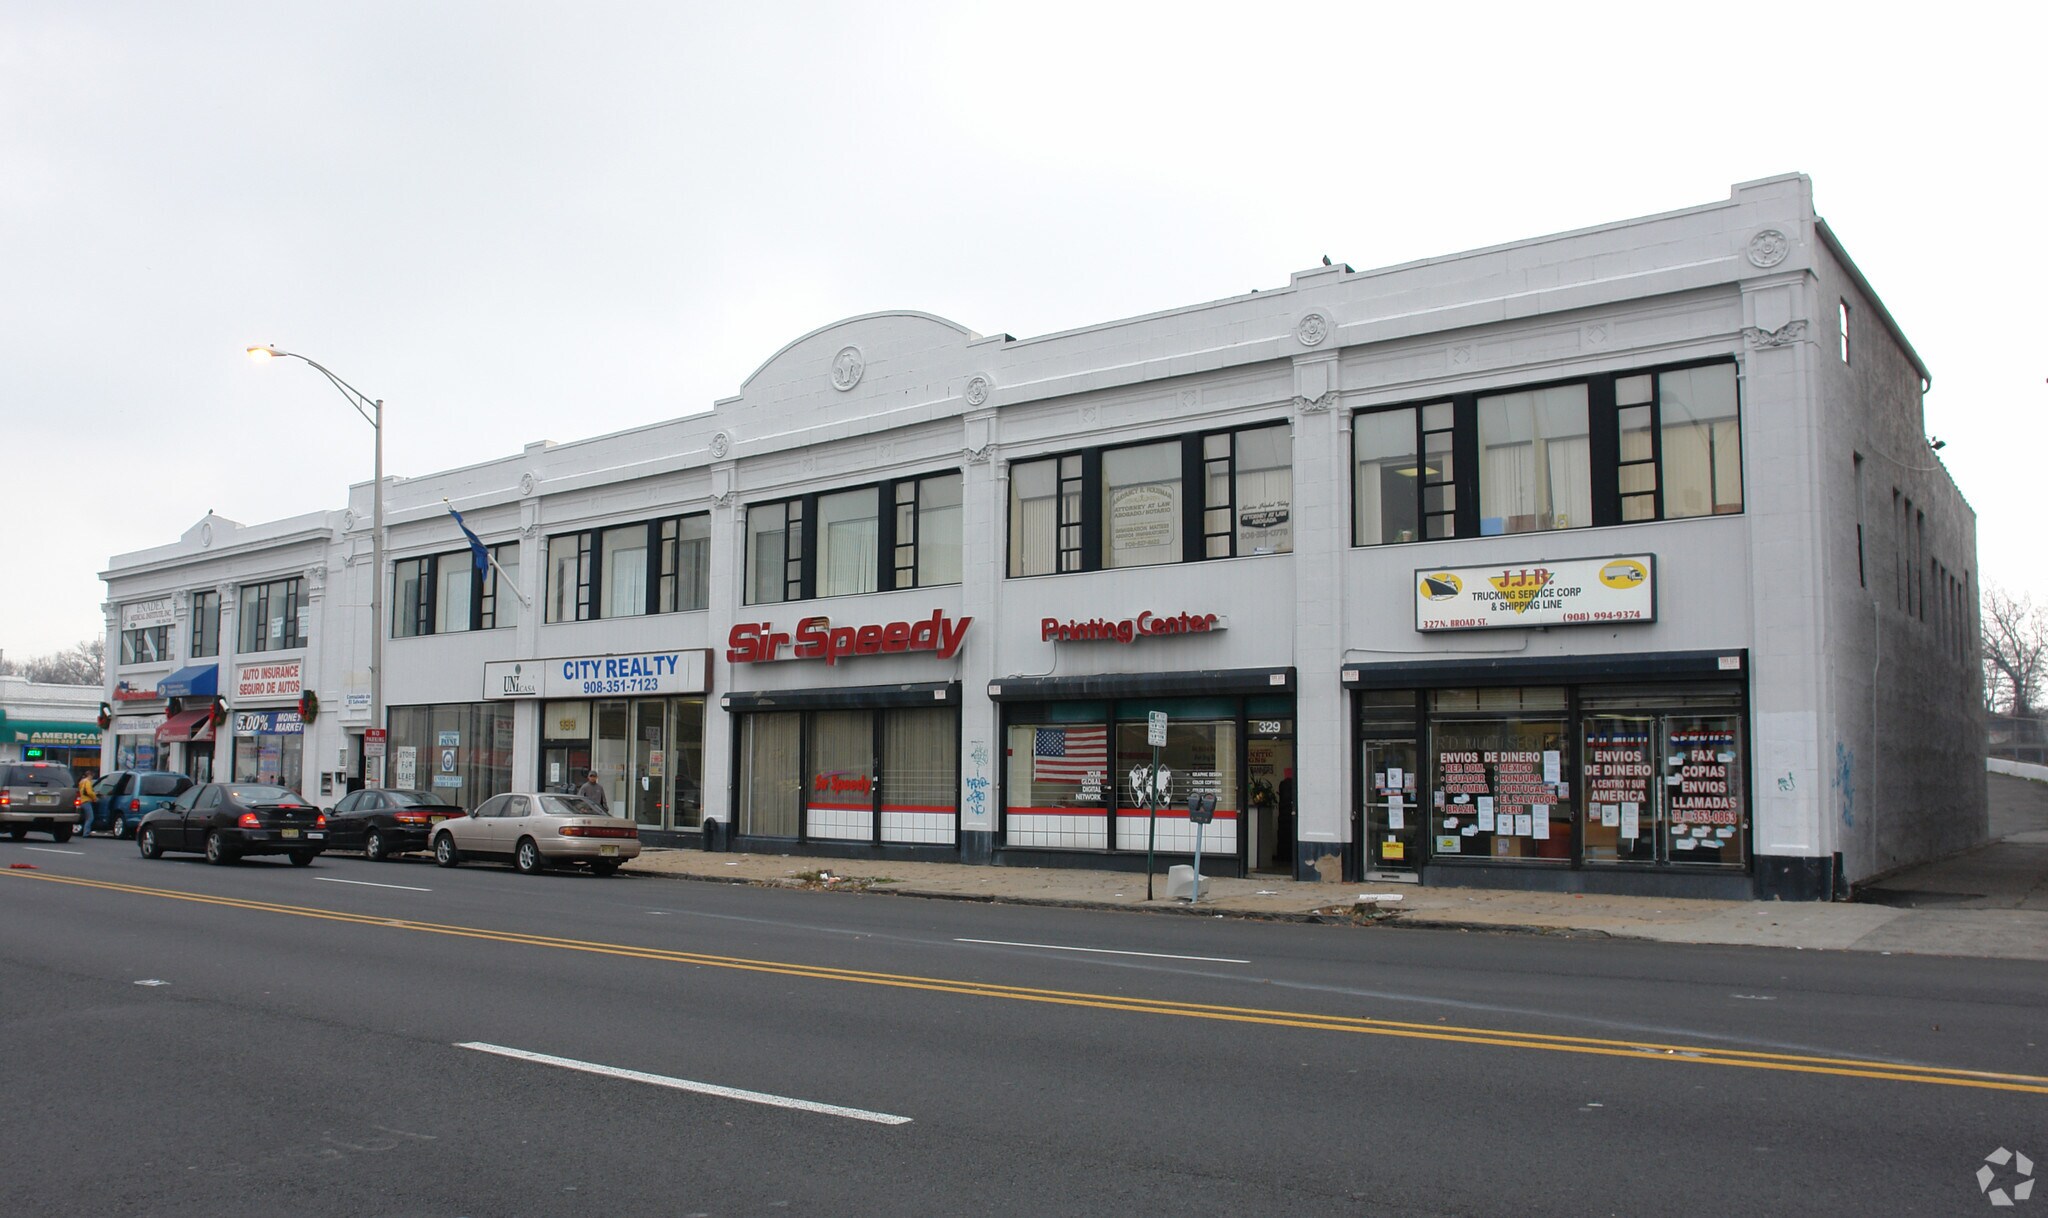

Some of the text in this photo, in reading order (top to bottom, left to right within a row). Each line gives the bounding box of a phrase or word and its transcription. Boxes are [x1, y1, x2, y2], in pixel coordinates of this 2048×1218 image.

[1472, 587, 1581, 601] TRUCKING SERVICE CORP
[1491, 600, 1562, 612] & SHIPPING LINE
[1563, 610, 1641, 623] (908) 994-9374
[1041, 610, 1218, 643] Printing Center
[1451, 619, 1475, 629] BROAD
[1477, 618, 1488, 627] ST.
[726, 608, 974, 667] Sir Speedy
[242, 665, 299, 681] AUTO INSURANCE
[563, 655, 679, 680] CITY REALTY
[239, 680, 300, 695] SEGURO DE AUTOS
[583, 678, 659, 694] 908-351-7123
[236, 714, 269, 731] 5.00%
[274, 722, 304, 732] MARKET
[1259, 721, 1280, 733] 329
[1670, 730, 1735, 746] SERVICE
[1440, 752, 1540, 763] ENVIOS DE DINERO
[1595, 751, 1641, 762] ENVIOS
[1692, 750, 1714, 762] FAX
[1446, 764, 1486, 773] REP. DOM.
[1500, 763, 1533, 773] MEXICO
[1585, 765, 1651, 776] DE DINERO
[1682, 766, 1725, 777] COPIAS
[1446, 774, 1486, 783] ECUADOR
[1592, 779, 1646, 789] A CENTRO Y SUR
[815, 774, 873, 796] Sir Speedy
[1446, 784, 1489, 793] COLOMBIA
[1500, 784, 1545, 793] PORTUGAL
[1682, 781, 1726, 793] ENVIOS
[1500, 795, 1558, 804] EL SALVADOR
[1591, 790, 1646, 801] AMERICA
[1672, 797, 1737, 809] LLAMADAS
[1446, 805, 1477, 814] BRAZIL
[1500, 805, 1523, 814] PERU
[1693, 810, 1738, 824] 353-0863
